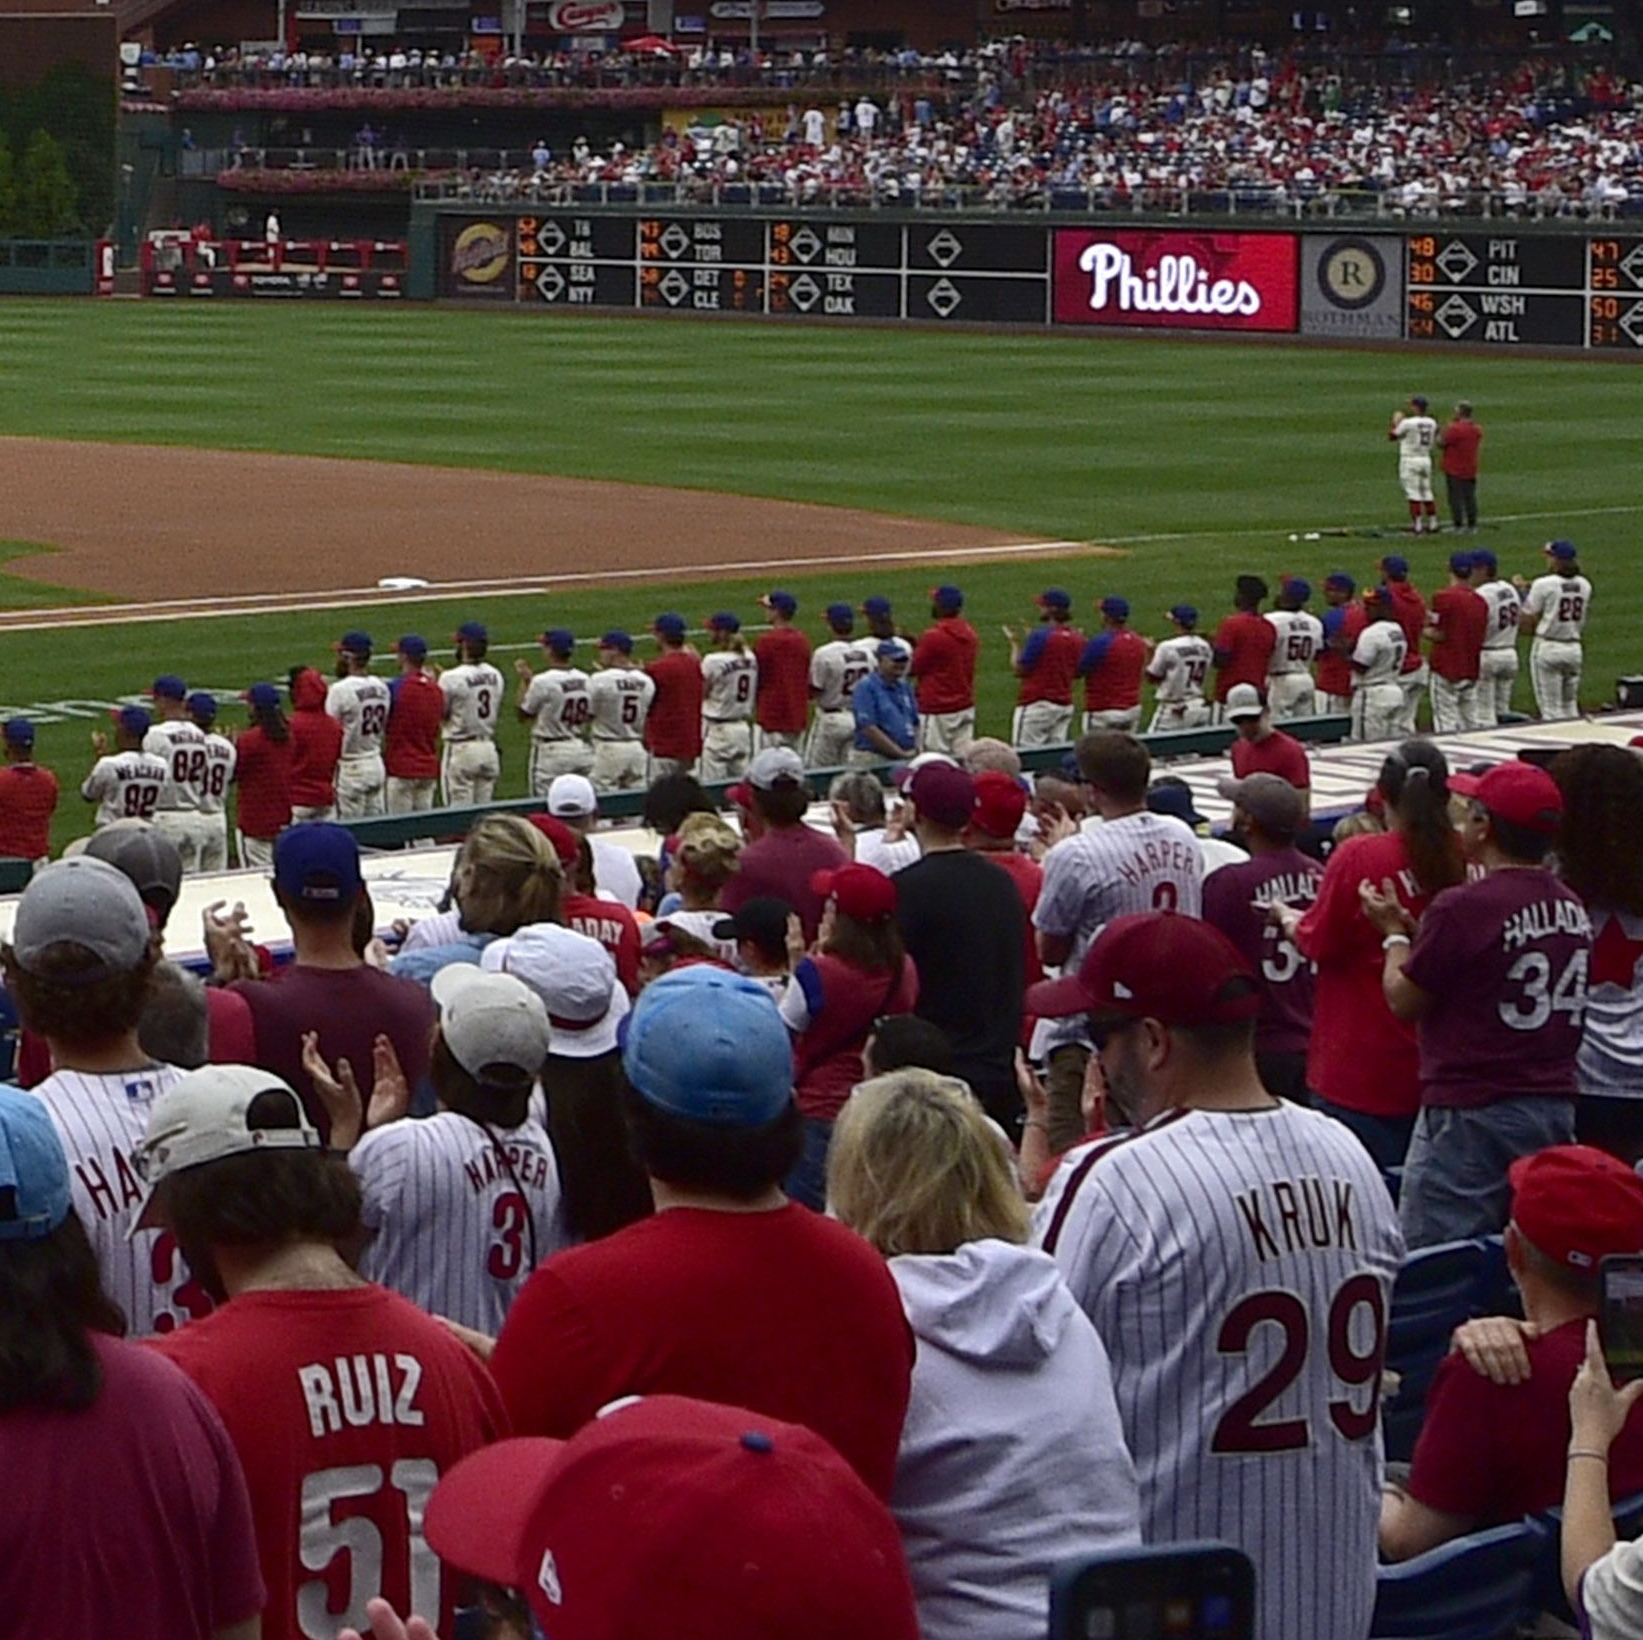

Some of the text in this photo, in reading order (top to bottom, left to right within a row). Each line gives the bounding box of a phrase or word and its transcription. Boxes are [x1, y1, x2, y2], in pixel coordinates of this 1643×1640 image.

[693, 222, 722, 240] BOS
[569, 240, 594, 258] BAL
[824, 248, 857, 266] HOU
[1489, 240, 1516, 258] PIT
[569, 264, 596, 282] SEA
[693, 270, 720, 287] DET
[826, 273, 854, 292] TEX
[1078, 241, 1261, 317] Phillies
[1341, 261, 1364, 286] R
[1487, 265, 1520, 285] CIN
[692, 291, 719, 309] CLE
[823, 296, 854, 314] OAK
[1480, 294, 1525, 315] WSH
[1484, 320, 1519, 342] ATL
[477, 688, 491, 719] 3
[622, 695, 639, 724] 5
[1119, 839, 1196, 888] HARPER
[1498, 948, 1590, 1032] 34
[465, 1146, 548, 1192] HARPER
[1237, 1176, 1358, 1261] KRUK
[488, 1190, 532, 1280] 3
[1211, 1273, 1387, 1455] 29
[298, 1353, 425, 1438] RUIZ
[295, 1458, 441, 1640] 51
